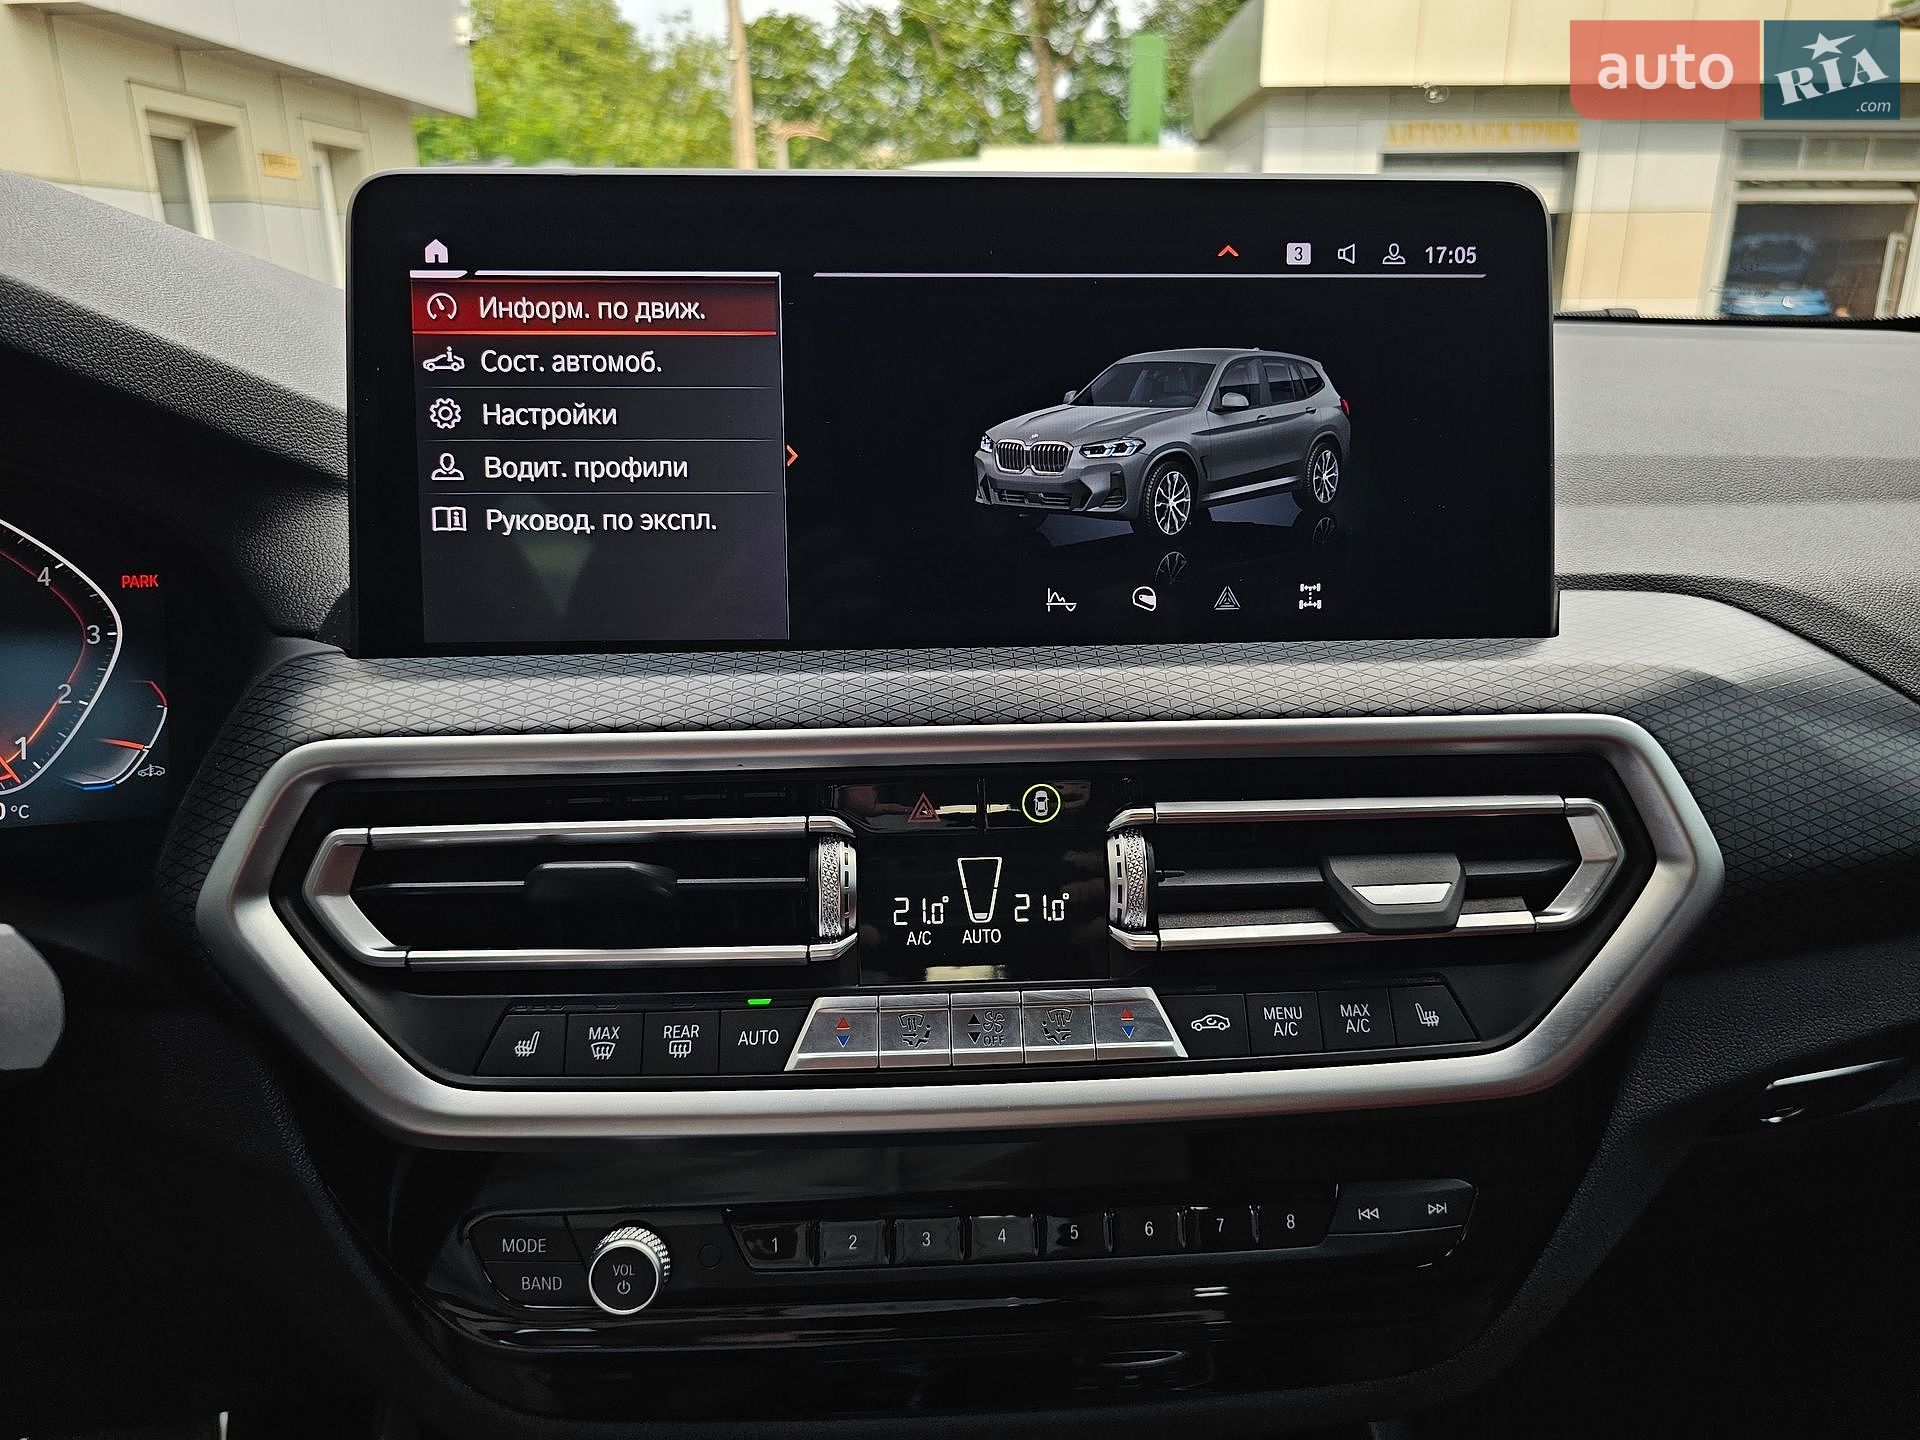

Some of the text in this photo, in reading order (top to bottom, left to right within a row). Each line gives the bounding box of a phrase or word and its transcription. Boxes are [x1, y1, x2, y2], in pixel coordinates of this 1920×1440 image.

[1294, 246, 1303, 262] 3
[1425, 246, 1477, 264] 17:05
[479, 296, 706, 323] Информ. по движ.
[481, 351, 662, 373] Сост. автомоб.
[483, 403, 618, 430] Настройки
[484, 457, 688, 483] Водит. профили
[486, 509, 717, 535] Руковод. по экспл.
[37, 567, 51, 586] 4
[122, 575, 159, 588] PARK
[87, 625, 100, 644] 3
[58, 684, 72, 704] 2
[15, 737, 27, 760] 1
[906, 930, 932, 946] A/C
[962, 928, 1002, 945] AUTO
[1263, 1006, 1303, 1021] MENU
[1340, 1003, 1371, 1018] MAX
[588, 1026, 620, 1041] MAX
[663, 1024, 700, 1040] REAR
[1273, 1021, 1299, 1037] A/C
[1345, 1018, 1371, 1034] A/C
[737, 1029, 779, 1047] AUTO
[983, 1035, 1006, 1047] OFF
[771, 1213, 1296, 1253] 1 2 3 4 5 6 7 8
[502, 1238, 547, 1254] MODE
[612, 1264, 636, 1277] VOL
[521, 1276, 563, 1292] BAND
